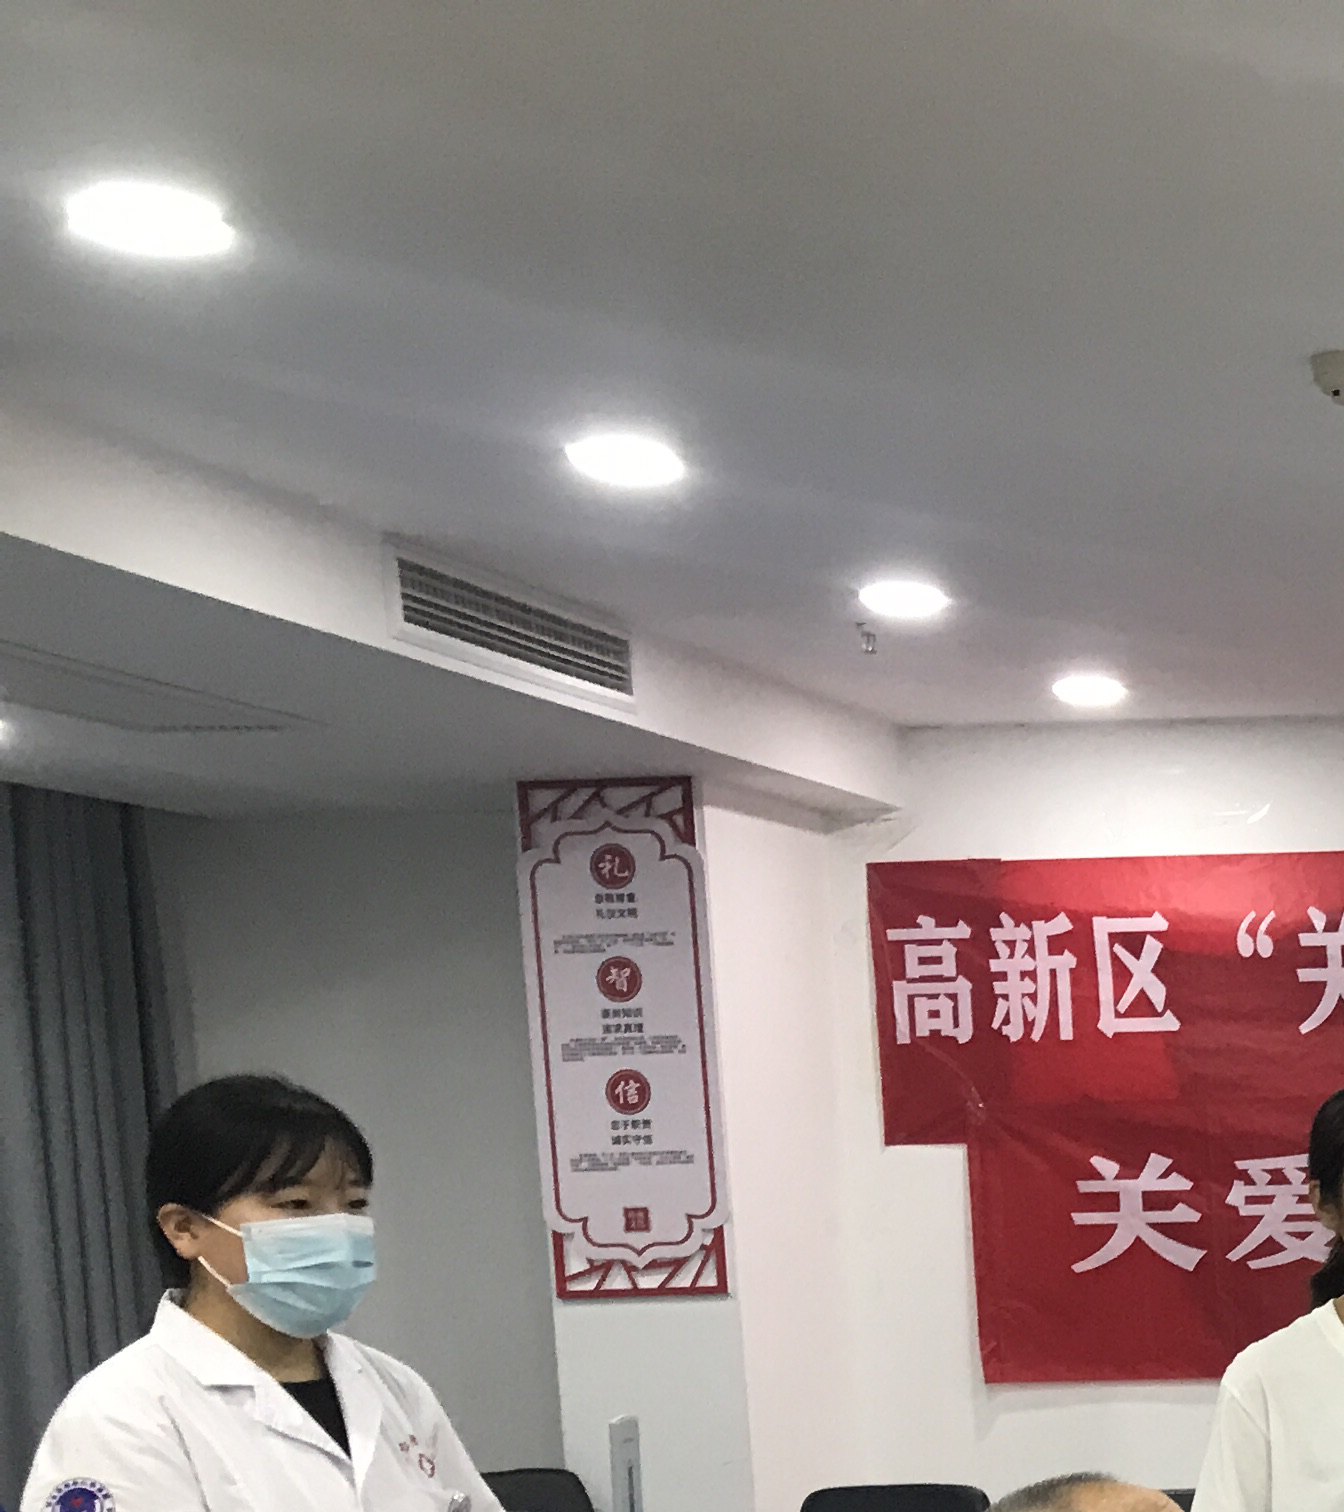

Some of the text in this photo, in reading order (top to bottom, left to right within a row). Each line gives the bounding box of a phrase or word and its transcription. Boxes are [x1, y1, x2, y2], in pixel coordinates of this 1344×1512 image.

[598, 854, 629, 879] 礼
[606, 966, 631, 992] 智
[615, 1080, 641, 1104] 信
